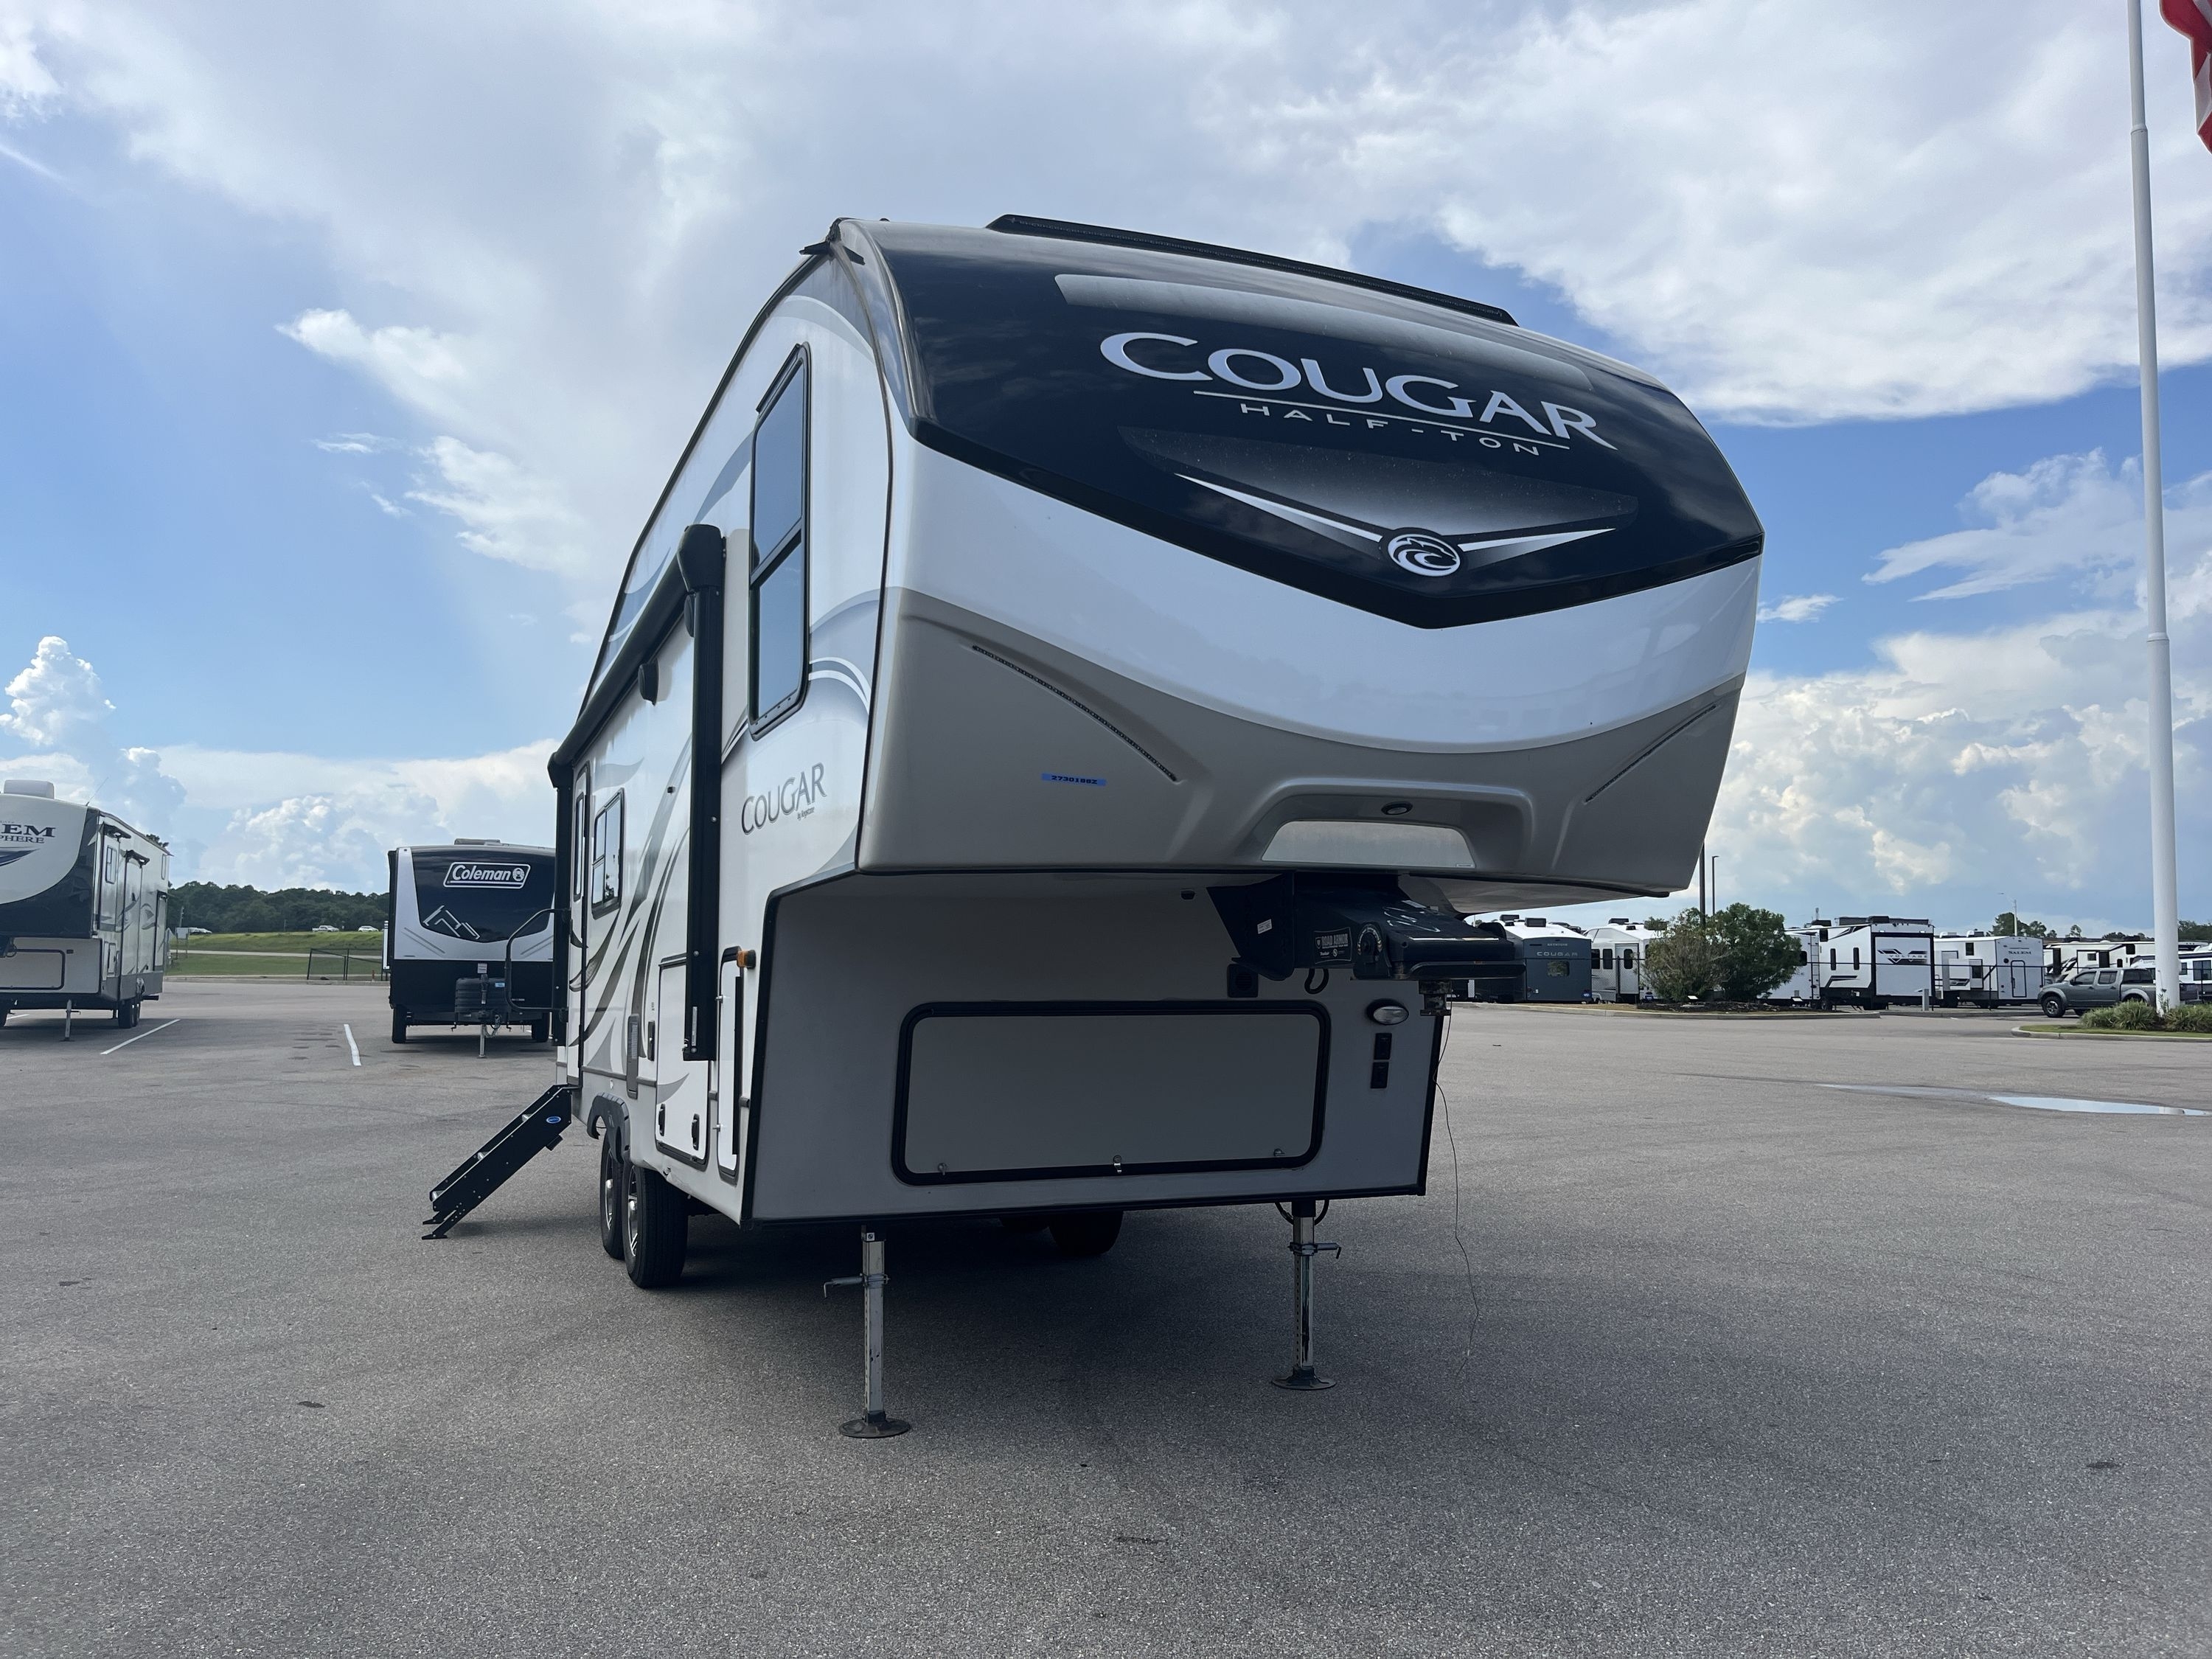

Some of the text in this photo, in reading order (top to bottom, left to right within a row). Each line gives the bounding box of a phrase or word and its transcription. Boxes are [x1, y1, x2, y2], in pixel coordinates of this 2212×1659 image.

[1100, 331, 1619, 451] COUGAR
[1240, 403, 1541, 456] HALF-TON
[741, 762, 827, 835] COUGAR
[452, 864, 512, 880] Coleman
